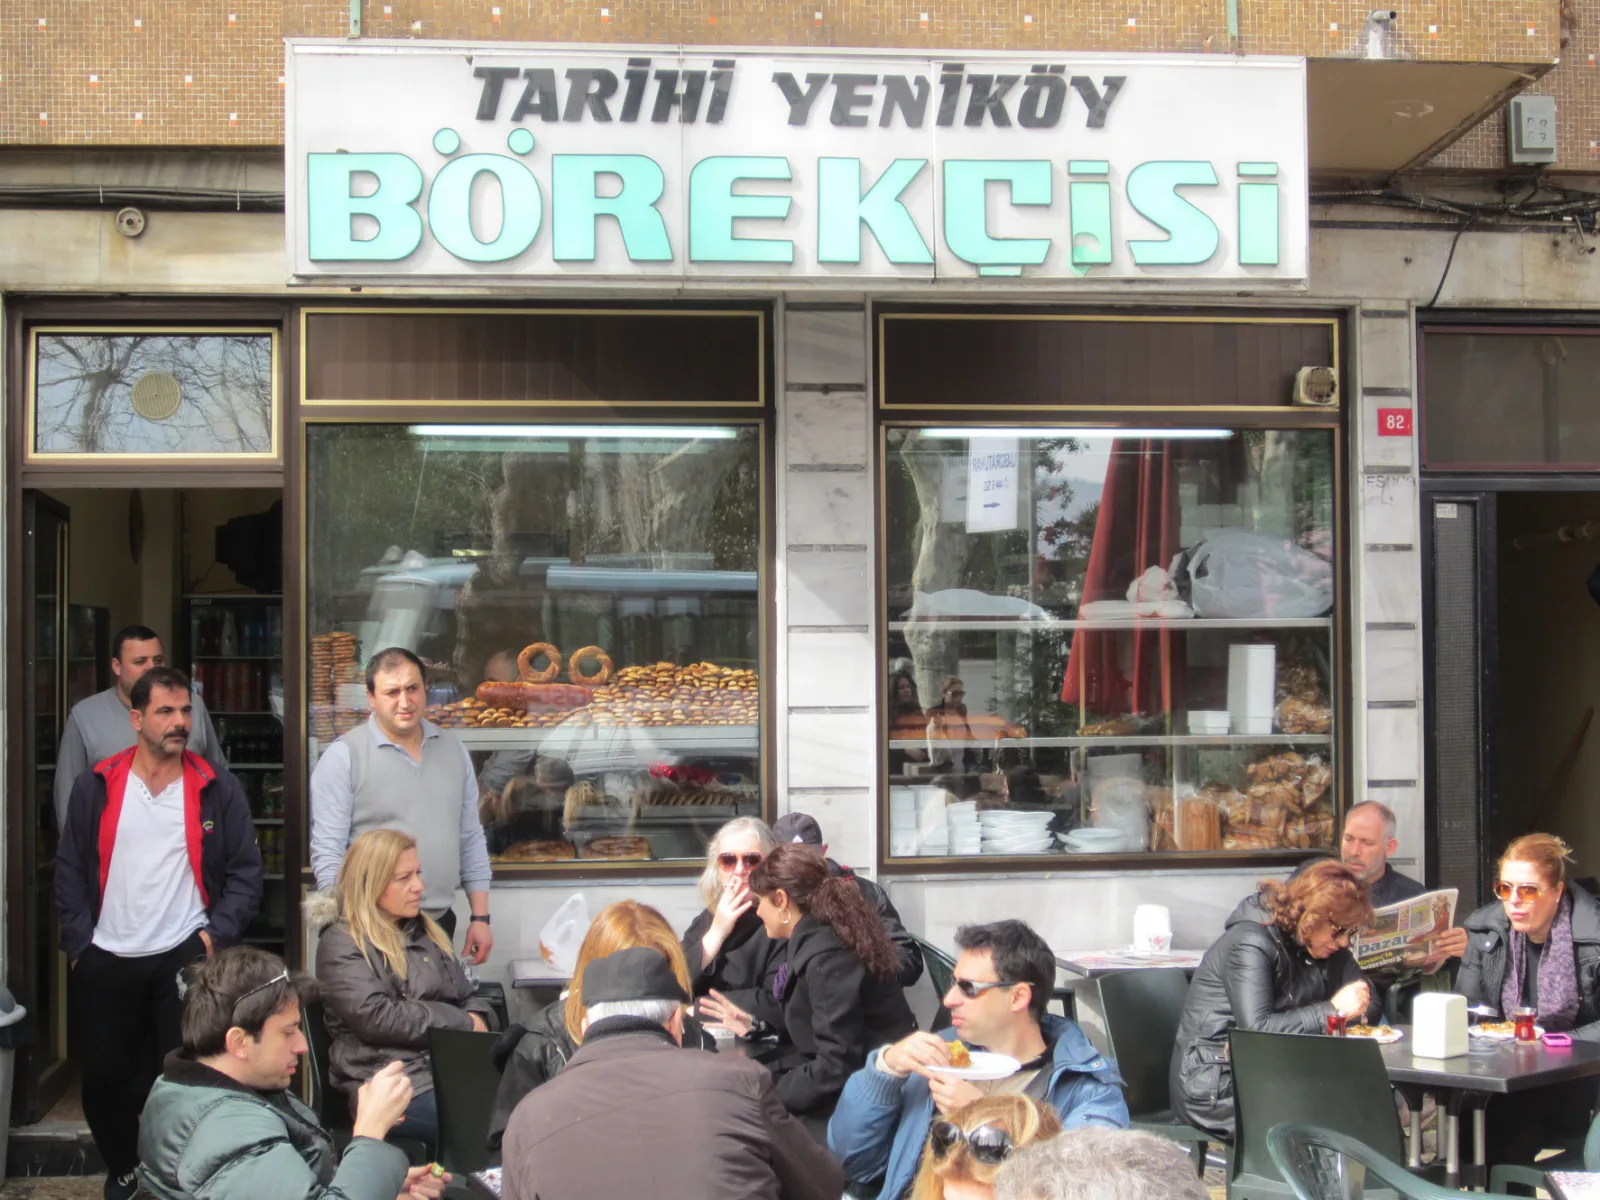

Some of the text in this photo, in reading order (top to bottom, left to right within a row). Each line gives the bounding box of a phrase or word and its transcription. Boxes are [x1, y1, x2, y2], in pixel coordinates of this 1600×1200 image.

[471, 57, 1128, 129] TARİHİ YENİKÖY
[306, 127, 1280, 277] BÖREKÇİSİ
[1386, 414, 1405, 430] 82
